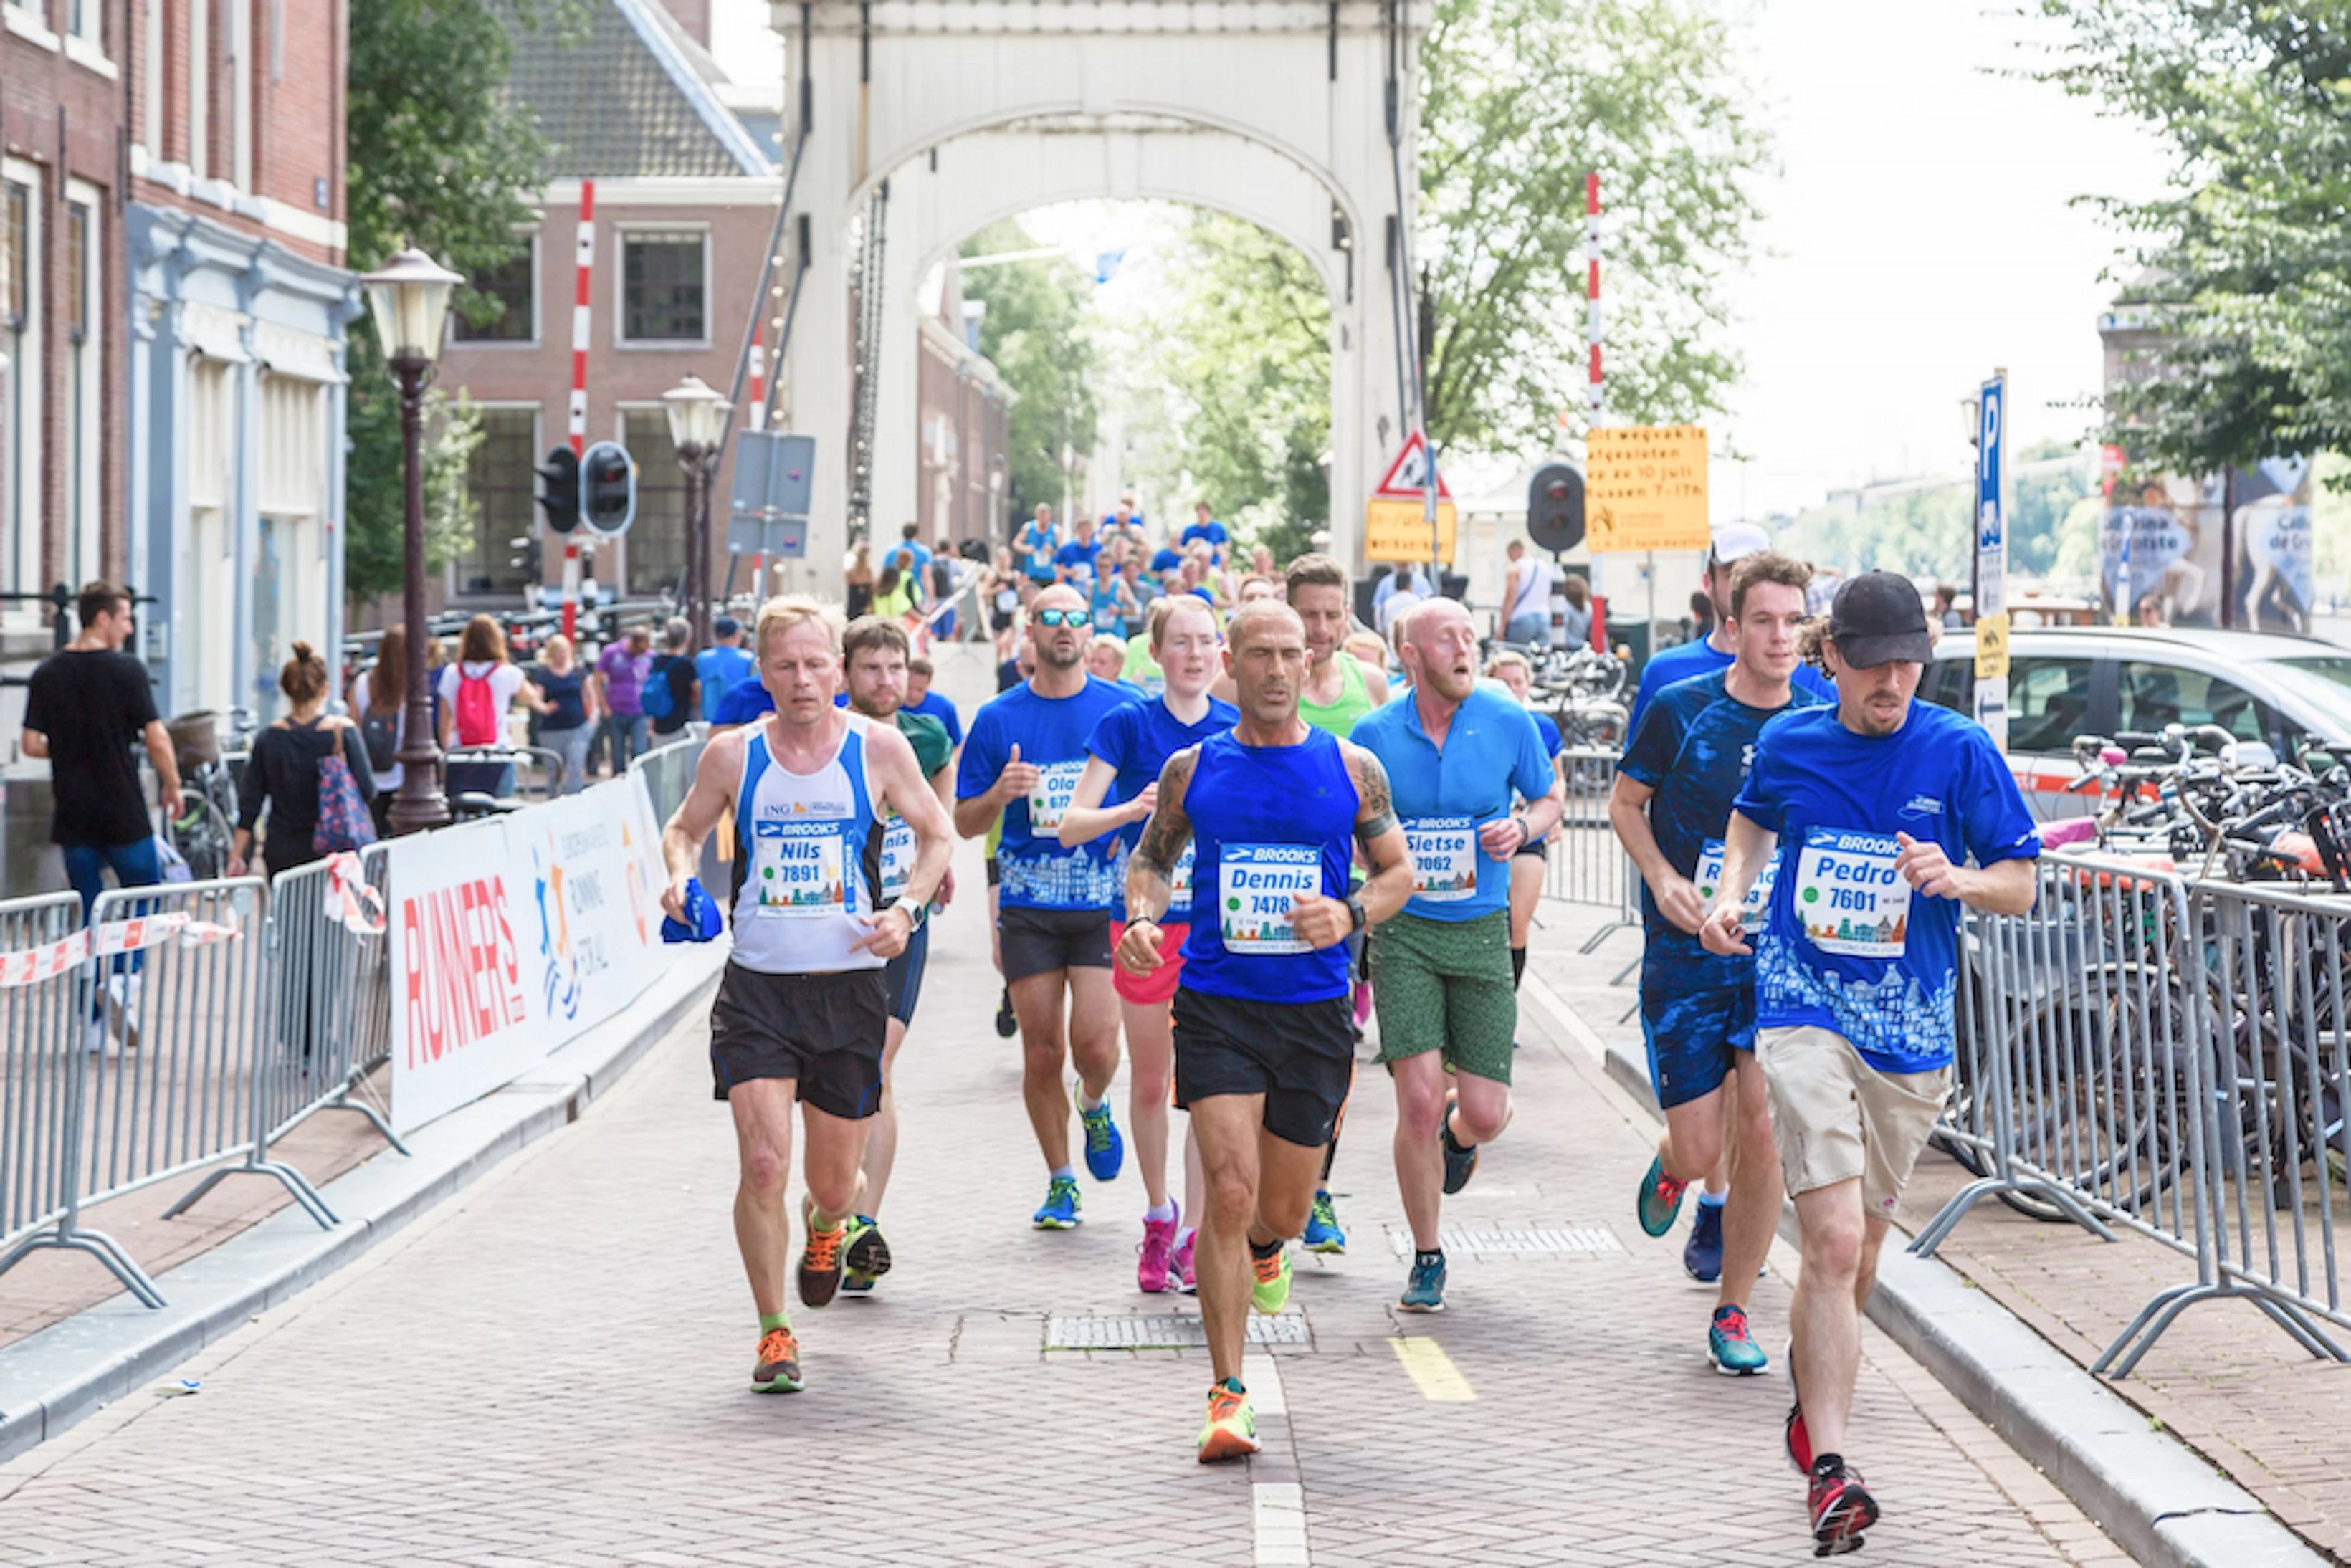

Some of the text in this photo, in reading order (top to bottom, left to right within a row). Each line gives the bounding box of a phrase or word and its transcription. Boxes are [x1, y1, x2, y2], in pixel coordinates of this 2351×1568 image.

[1983, 394, 2000, 479] P
[764, 803, 790, 816] ING
[782, 823, 840, 836] BROOKS
[1417, 818, 1471, 829] BROOKS
[780, 841, 821, 860] Nils
[1838, 834, 1904, 855] BROOK
[1253, 848, 1317, 864] BROOKS
[781, 864, 819, 882] 7891
[1231, 869, 1315, 889] Dennis
[1816, 856, 1897, 886] Pedro
[1251, 895, 1290, 914] 7478
[1829, 887, 1877, 913] 7601
[404, 874, 519, 1071] RUNNERS
